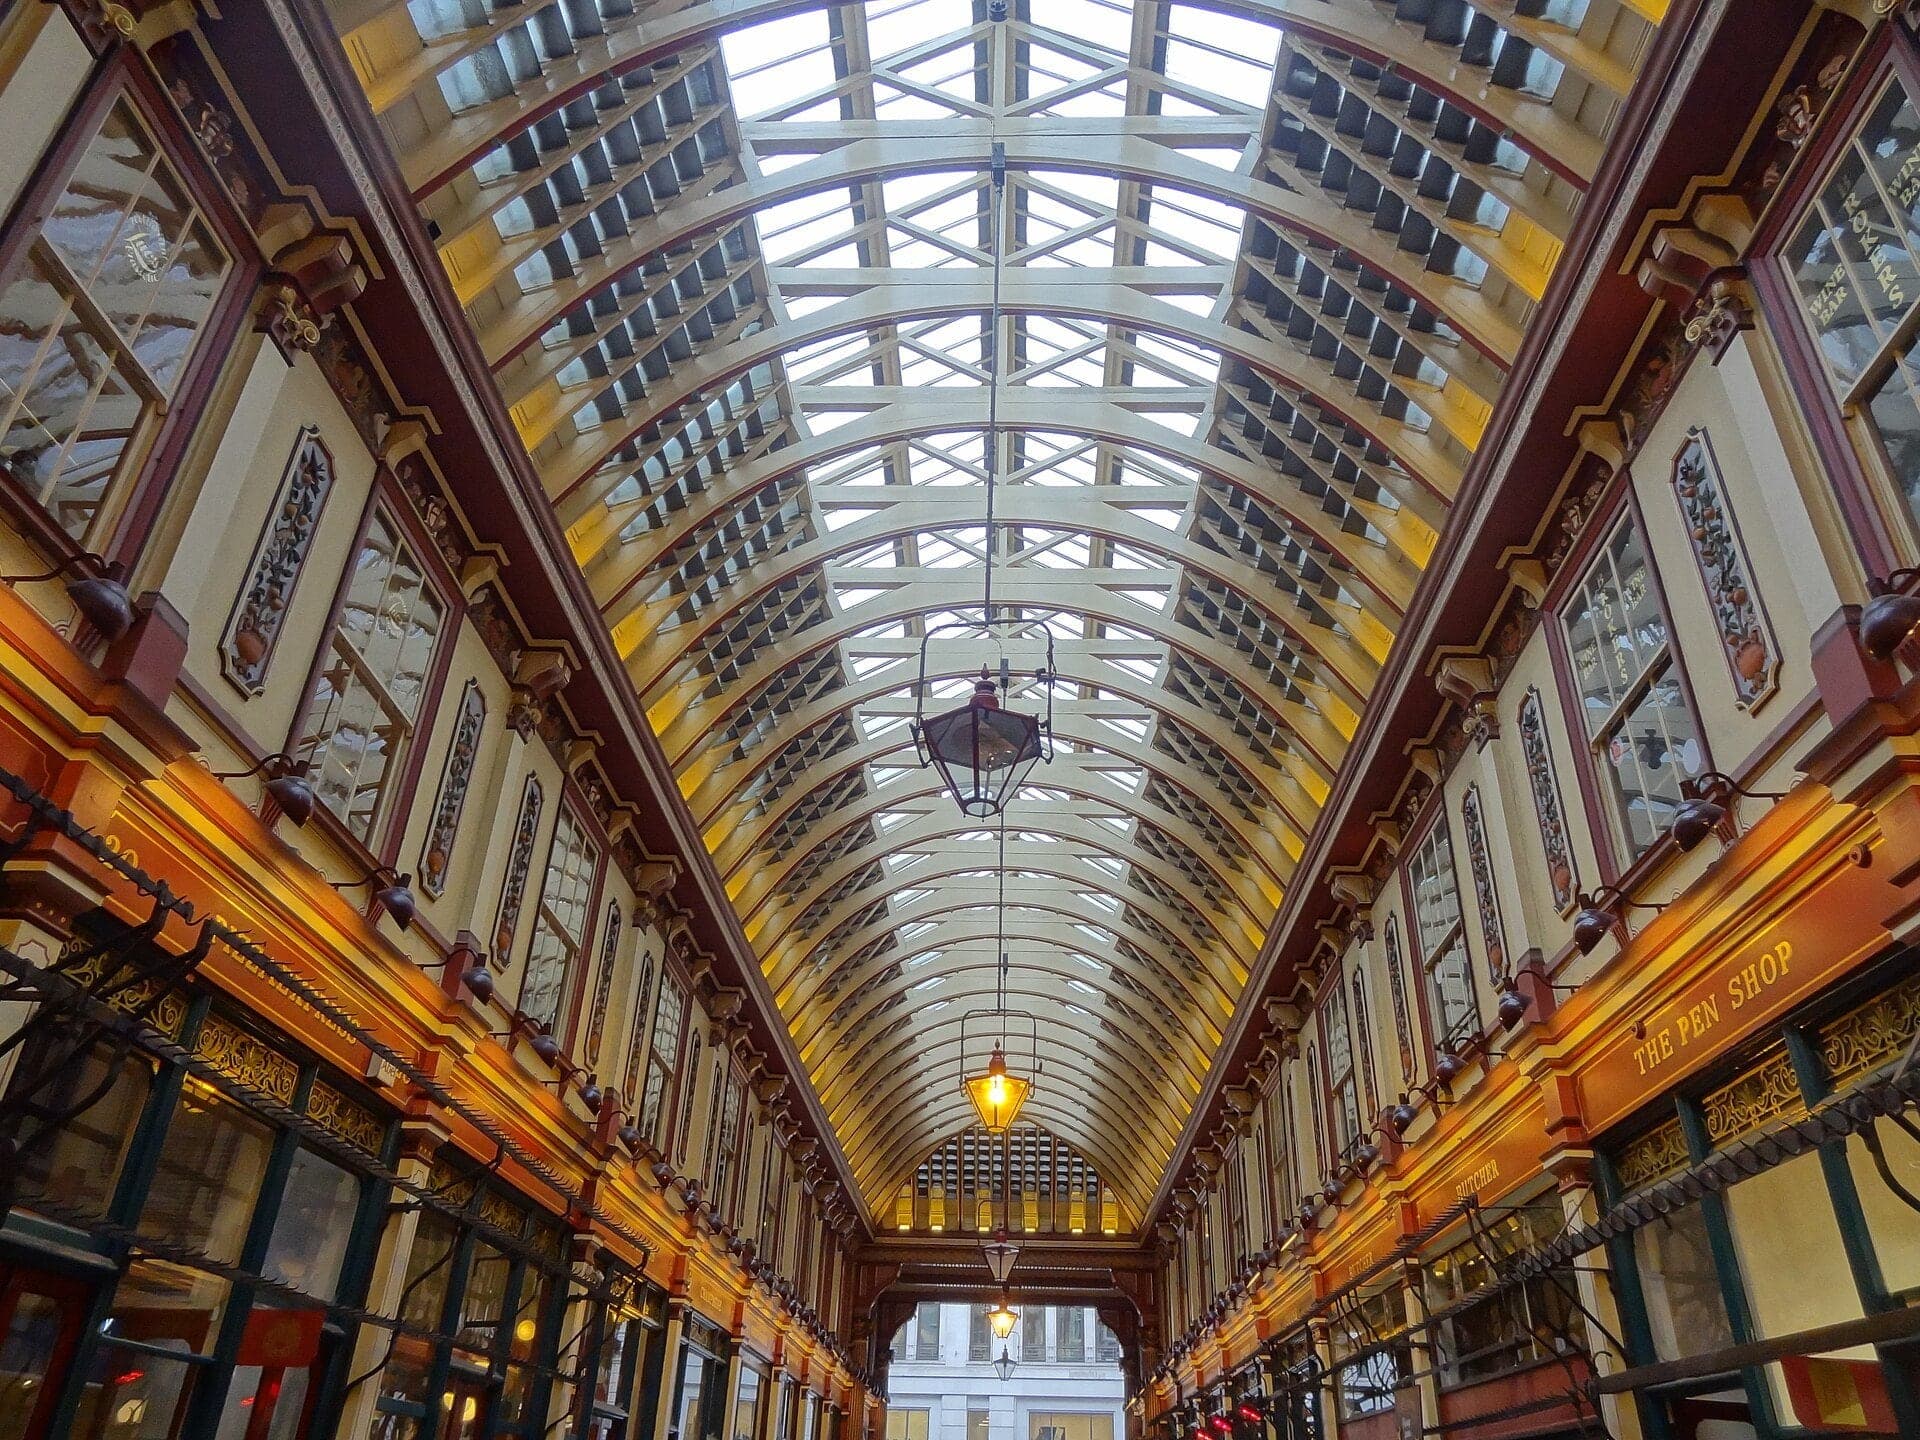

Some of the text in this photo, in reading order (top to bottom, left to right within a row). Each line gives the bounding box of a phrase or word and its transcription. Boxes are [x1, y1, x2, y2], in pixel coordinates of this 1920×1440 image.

[1887, 142, 1920, 197] WIN
[1899, 176, 1920, 209] BA
[1809, 263, 1846, 316] WINE
[1820, 286, 1848, 327] BAR
[1633, 941, 1793, 1076] THE PEN SHOP
[1455, 1159, 1500, 1204] BUTCHER
